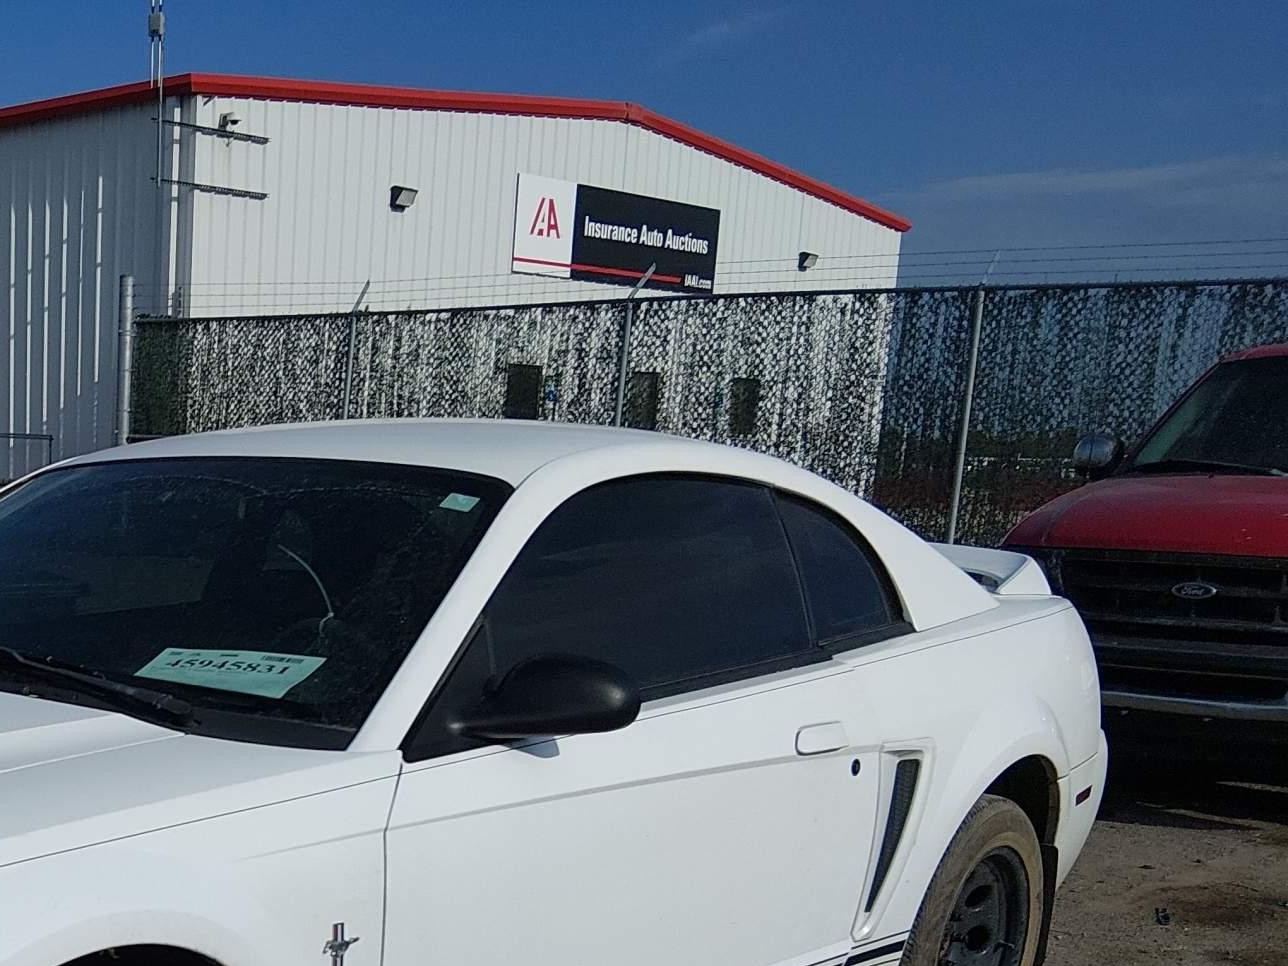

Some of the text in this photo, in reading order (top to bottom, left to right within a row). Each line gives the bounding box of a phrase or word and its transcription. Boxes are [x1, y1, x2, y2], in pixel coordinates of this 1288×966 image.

[584, 215, 709, 255] Insurance Auto Auctions
[1181, 586, 1205, 596] Ford
[165, 658, 291, 675] 45945831
